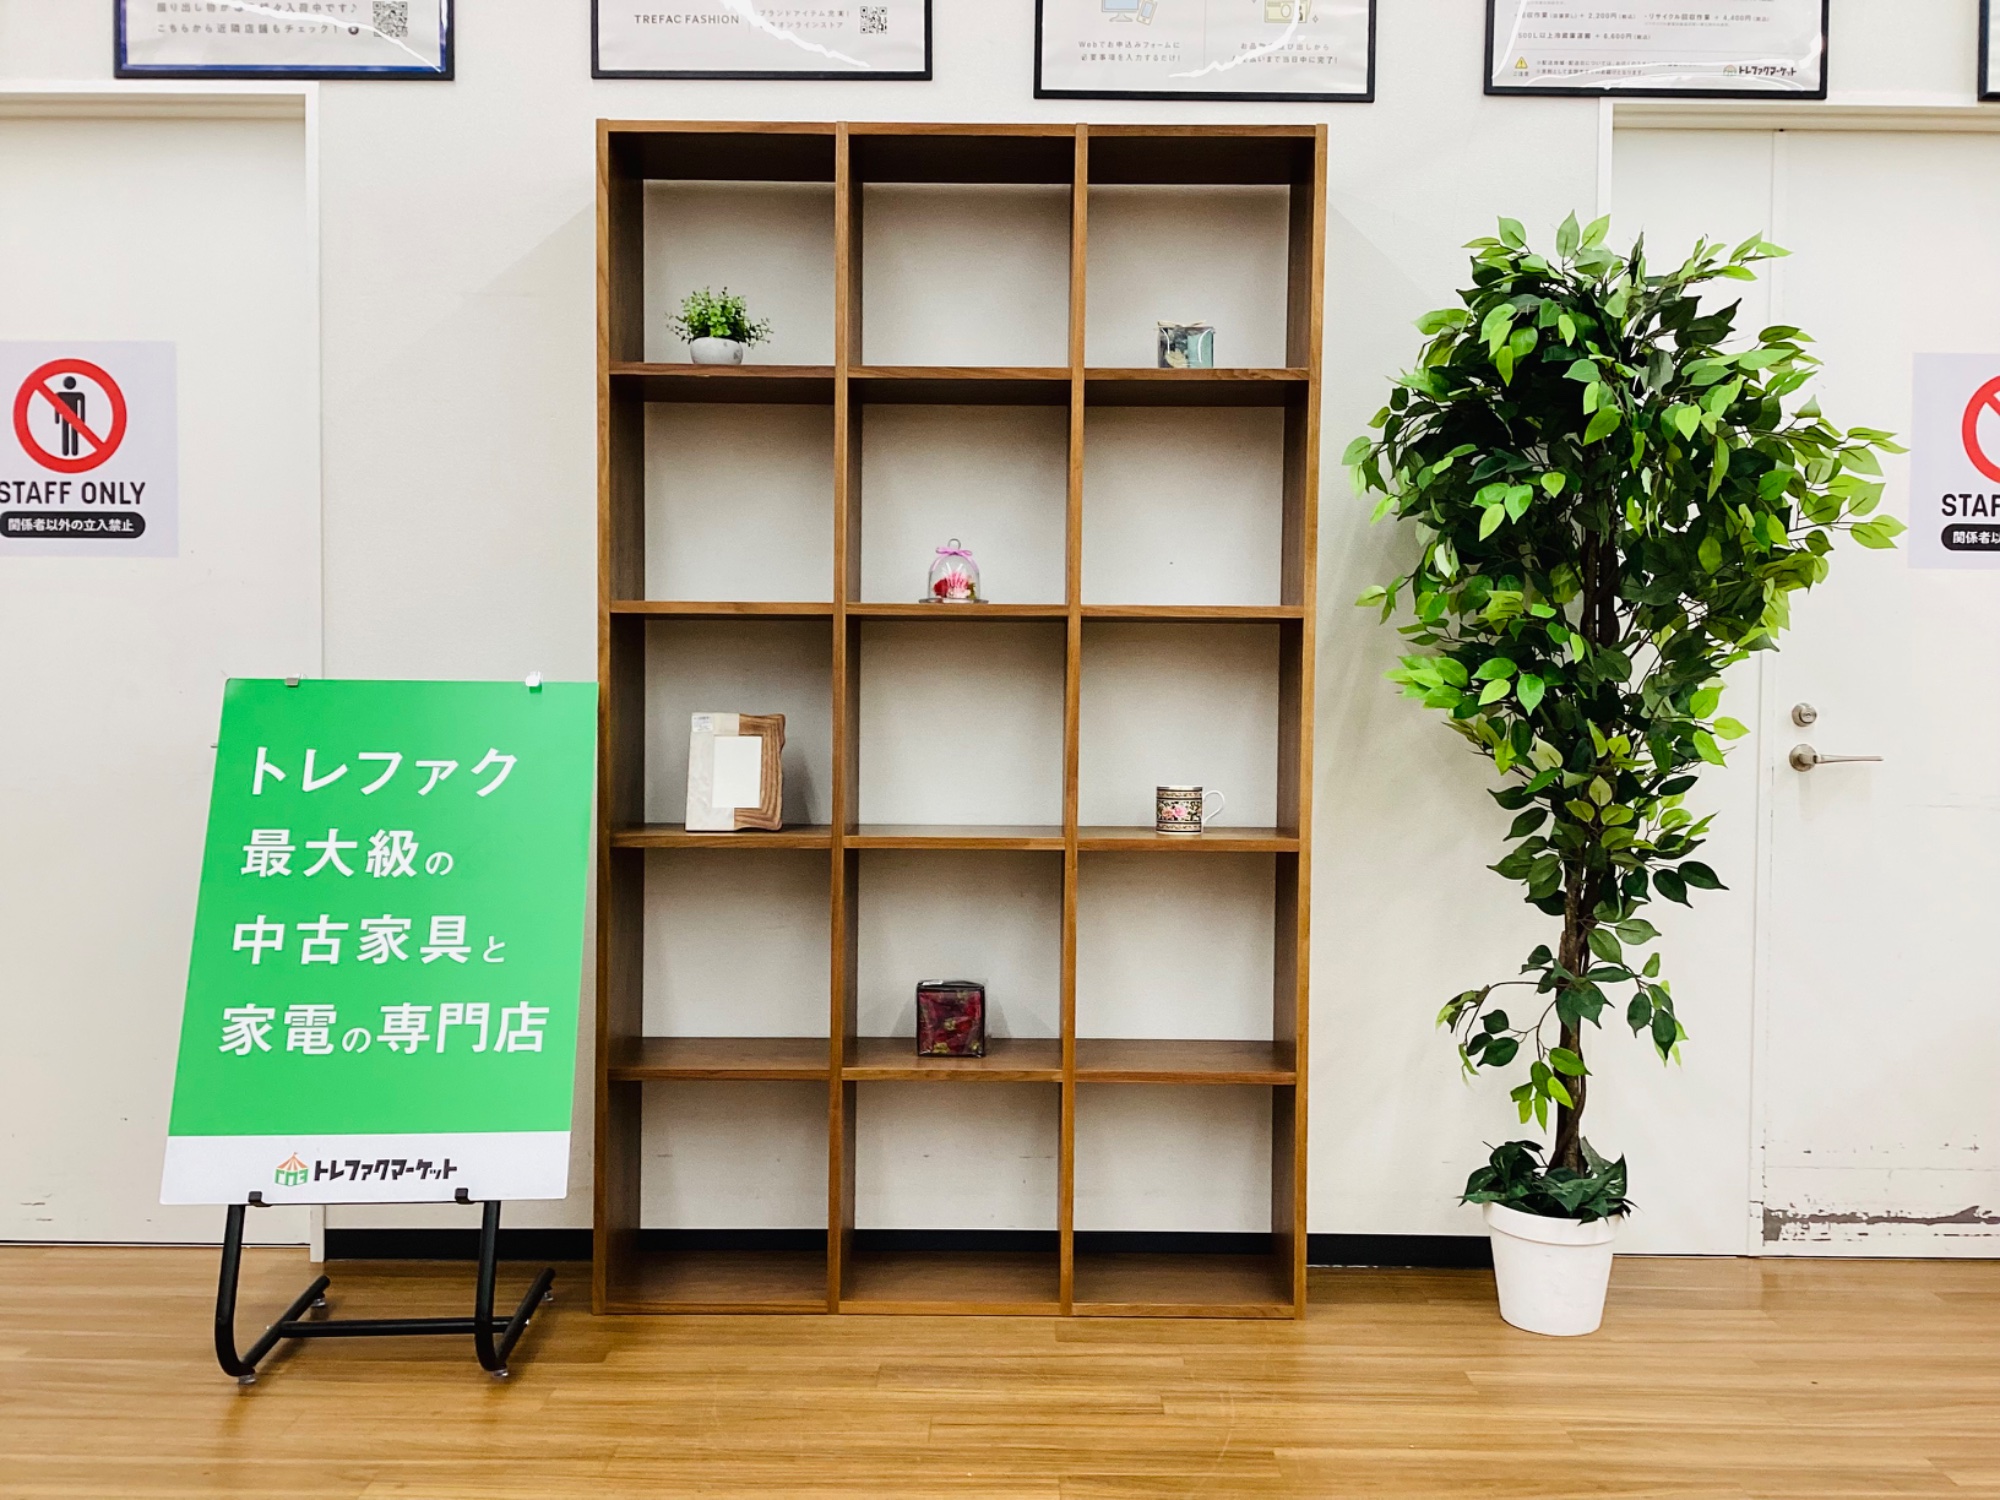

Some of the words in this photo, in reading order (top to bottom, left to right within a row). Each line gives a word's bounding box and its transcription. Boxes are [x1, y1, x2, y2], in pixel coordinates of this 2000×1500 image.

[634, 14, 682, 24] TREFAC
[685, 14, 739, 24] FASHION
[0, 480, 72, 505] STAFF
[81, 481, 146, 505] ONLY
[8, 517, 135, 533] 関係者以外の立入禁止
[251, 746, 519, 798] トレファク
[239, 827, 454, 879] 最大級の
[231, 913, 506, 965] 中古家具と
[218, 1000, 551, 1056] 家電の専門店
[313, 1157, 458, 1183] トレファクマーケット
